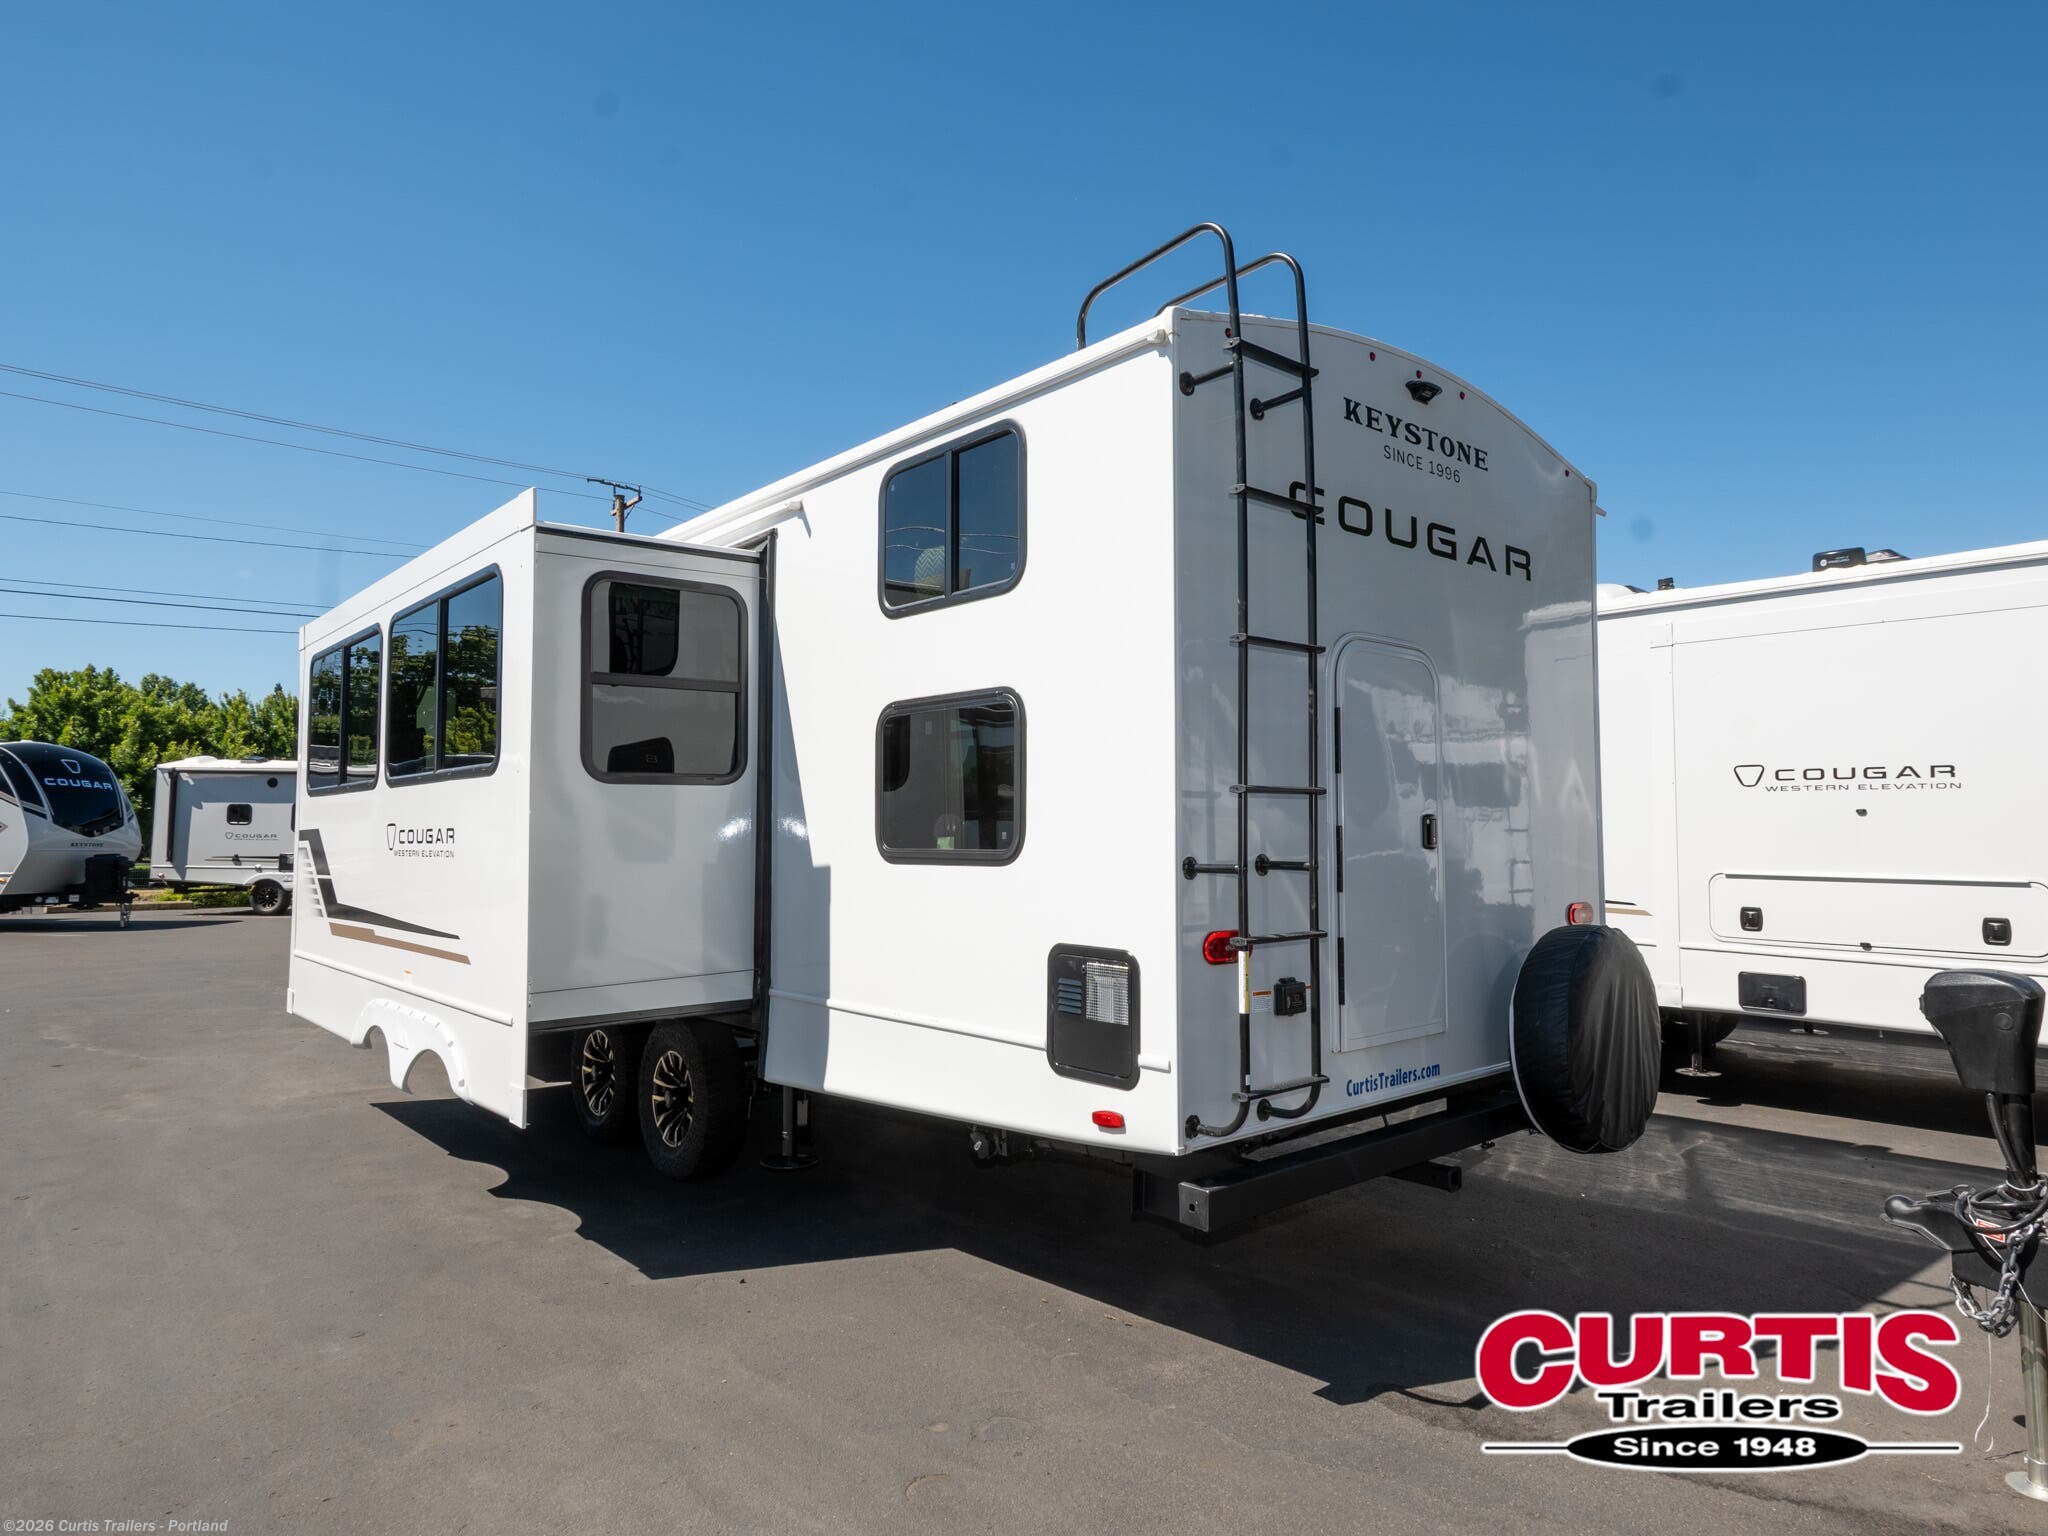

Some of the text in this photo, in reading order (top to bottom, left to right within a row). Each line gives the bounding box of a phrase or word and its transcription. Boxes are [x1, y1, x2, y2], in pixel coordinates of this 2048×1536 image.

[1343, 397, 1489, 472] KEYSTONE
[1383, 444, 1462, 484] SINCE 1996
[1289, 480, 1532, 582] COUGAR
[1775, 764, 1957, 781] COUGAR
[44, 777, 114, 791] COUGAR
[1765, 782, 1962, 792] WESTERN ELEVATION
[398, 827, 455, 844] COUGAR
[421, 849, 455, 859] ELEVATION
[1346, 1063, 1441, 1097] CurtisTrailers.com
